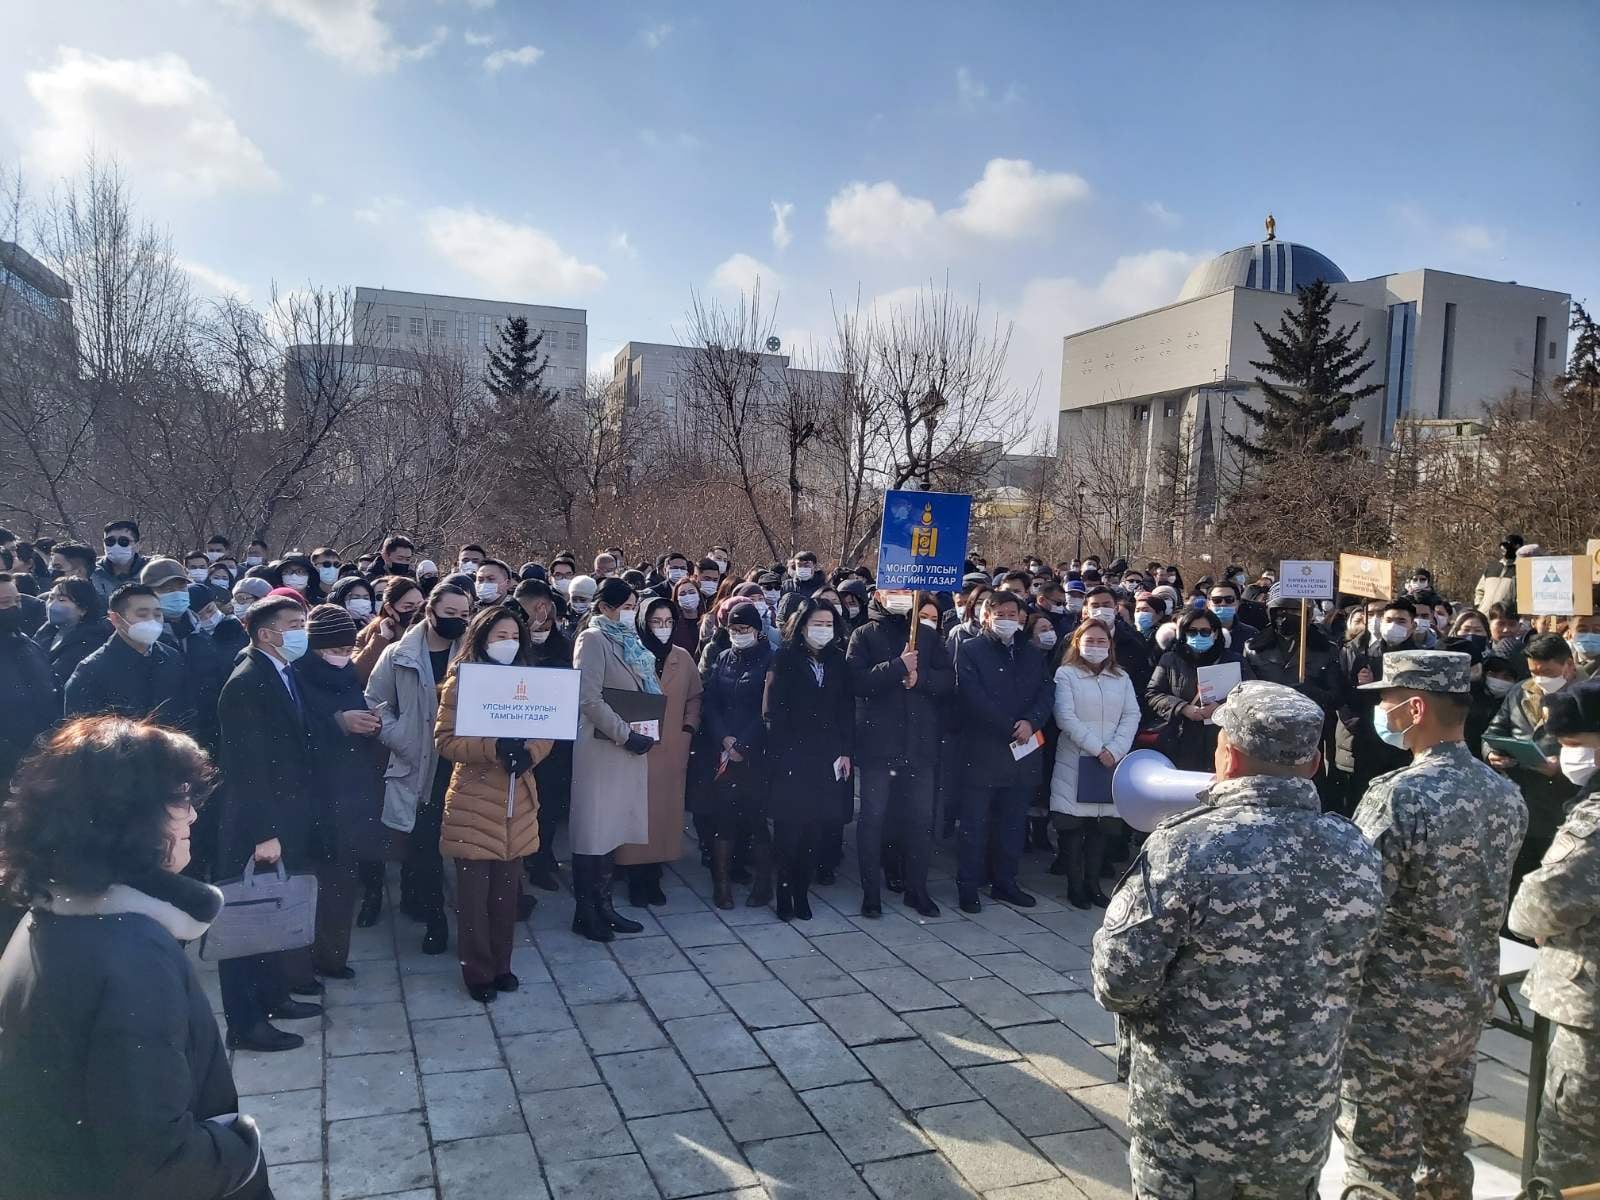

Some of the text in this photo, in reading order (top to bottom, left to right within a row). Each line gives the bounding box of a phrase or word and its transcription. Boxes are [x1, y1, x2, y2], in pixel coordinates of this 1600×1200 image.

[885, 564, 958, 574] МОНГОЛ УЛСЫН
[884, 574, 957, 585] ЗАСГИЙН ГАЗАР
[482, 703, 511, 711] УЛСЫН
[490, 712, 523, 720] ТАМГЫН
